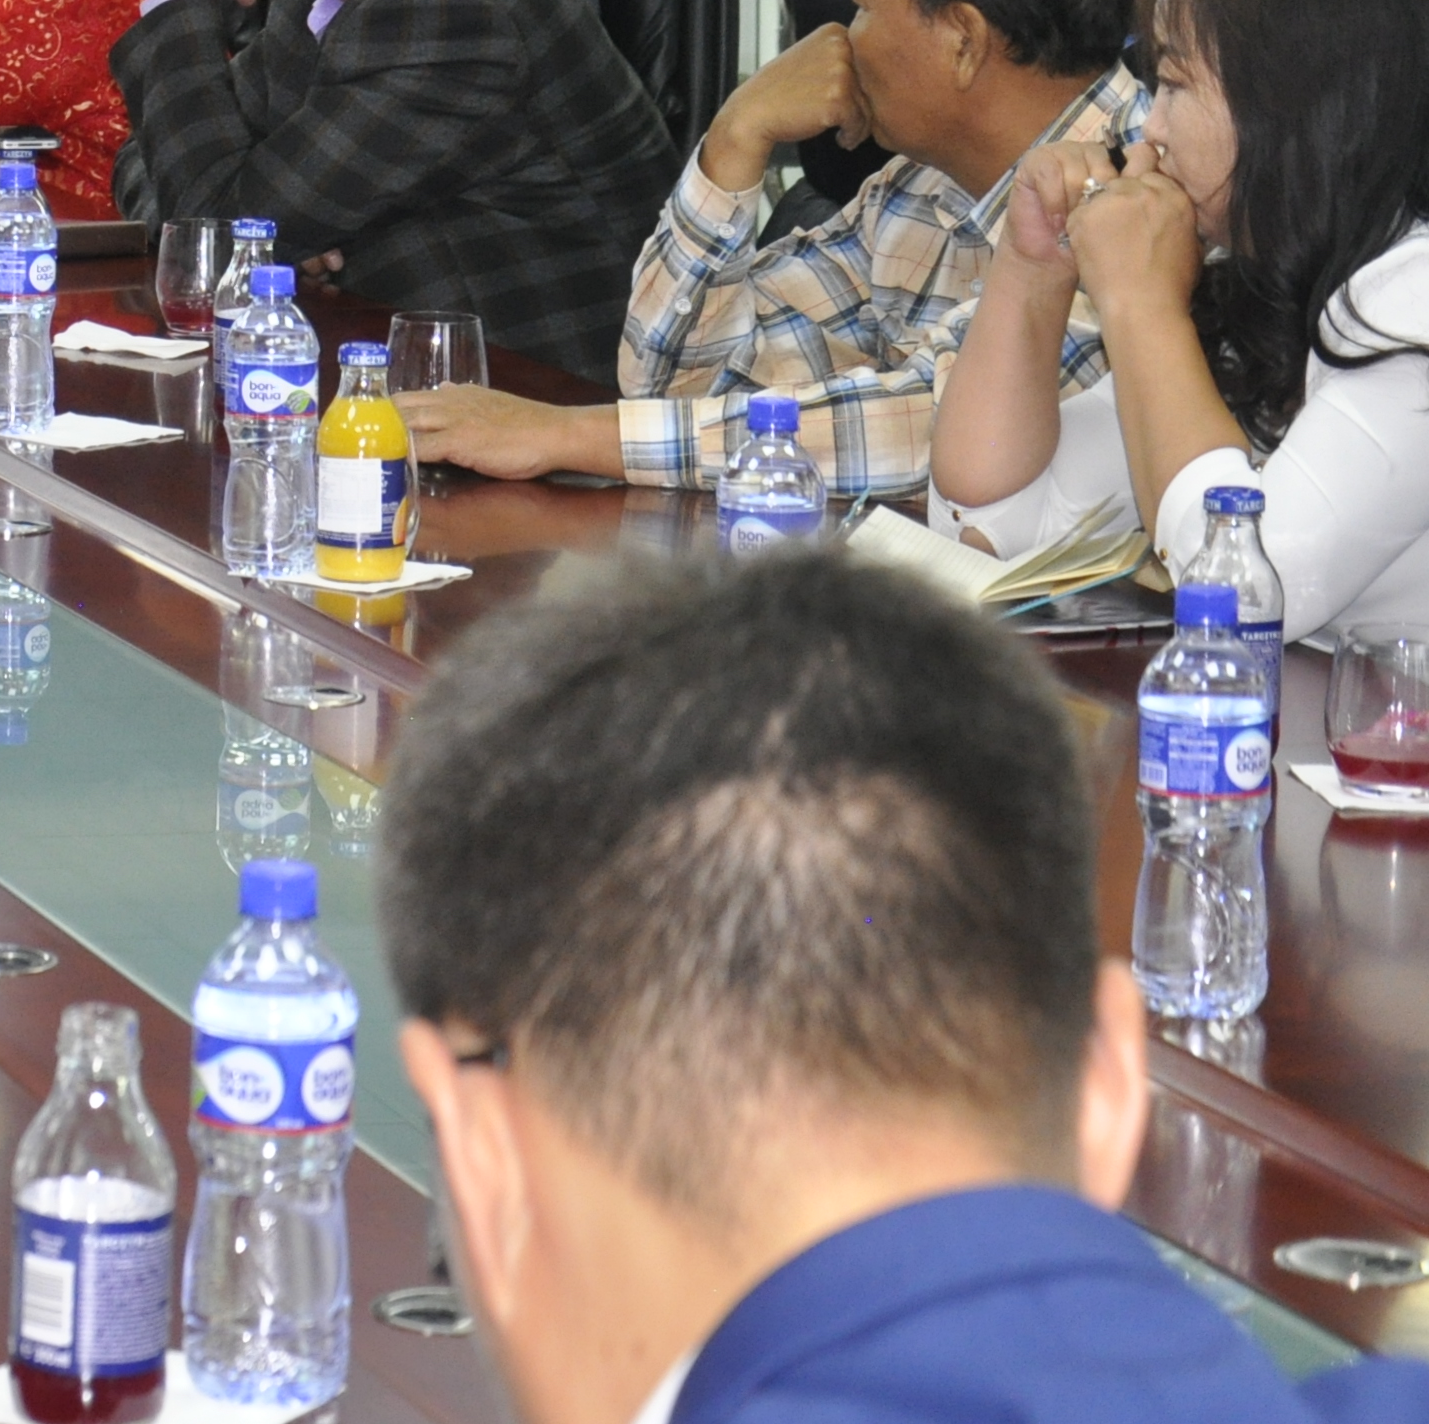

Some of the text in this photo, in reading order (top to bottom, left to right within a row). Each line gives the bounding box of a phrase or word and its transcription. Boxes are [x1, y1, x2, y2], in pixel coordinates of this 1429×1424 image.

[36, 264, 53, 273] bon-
[249, 380, 278, 391] bon-
[249, 391, 282, 403] aqua
[737, 526, 769, 542] bon-
